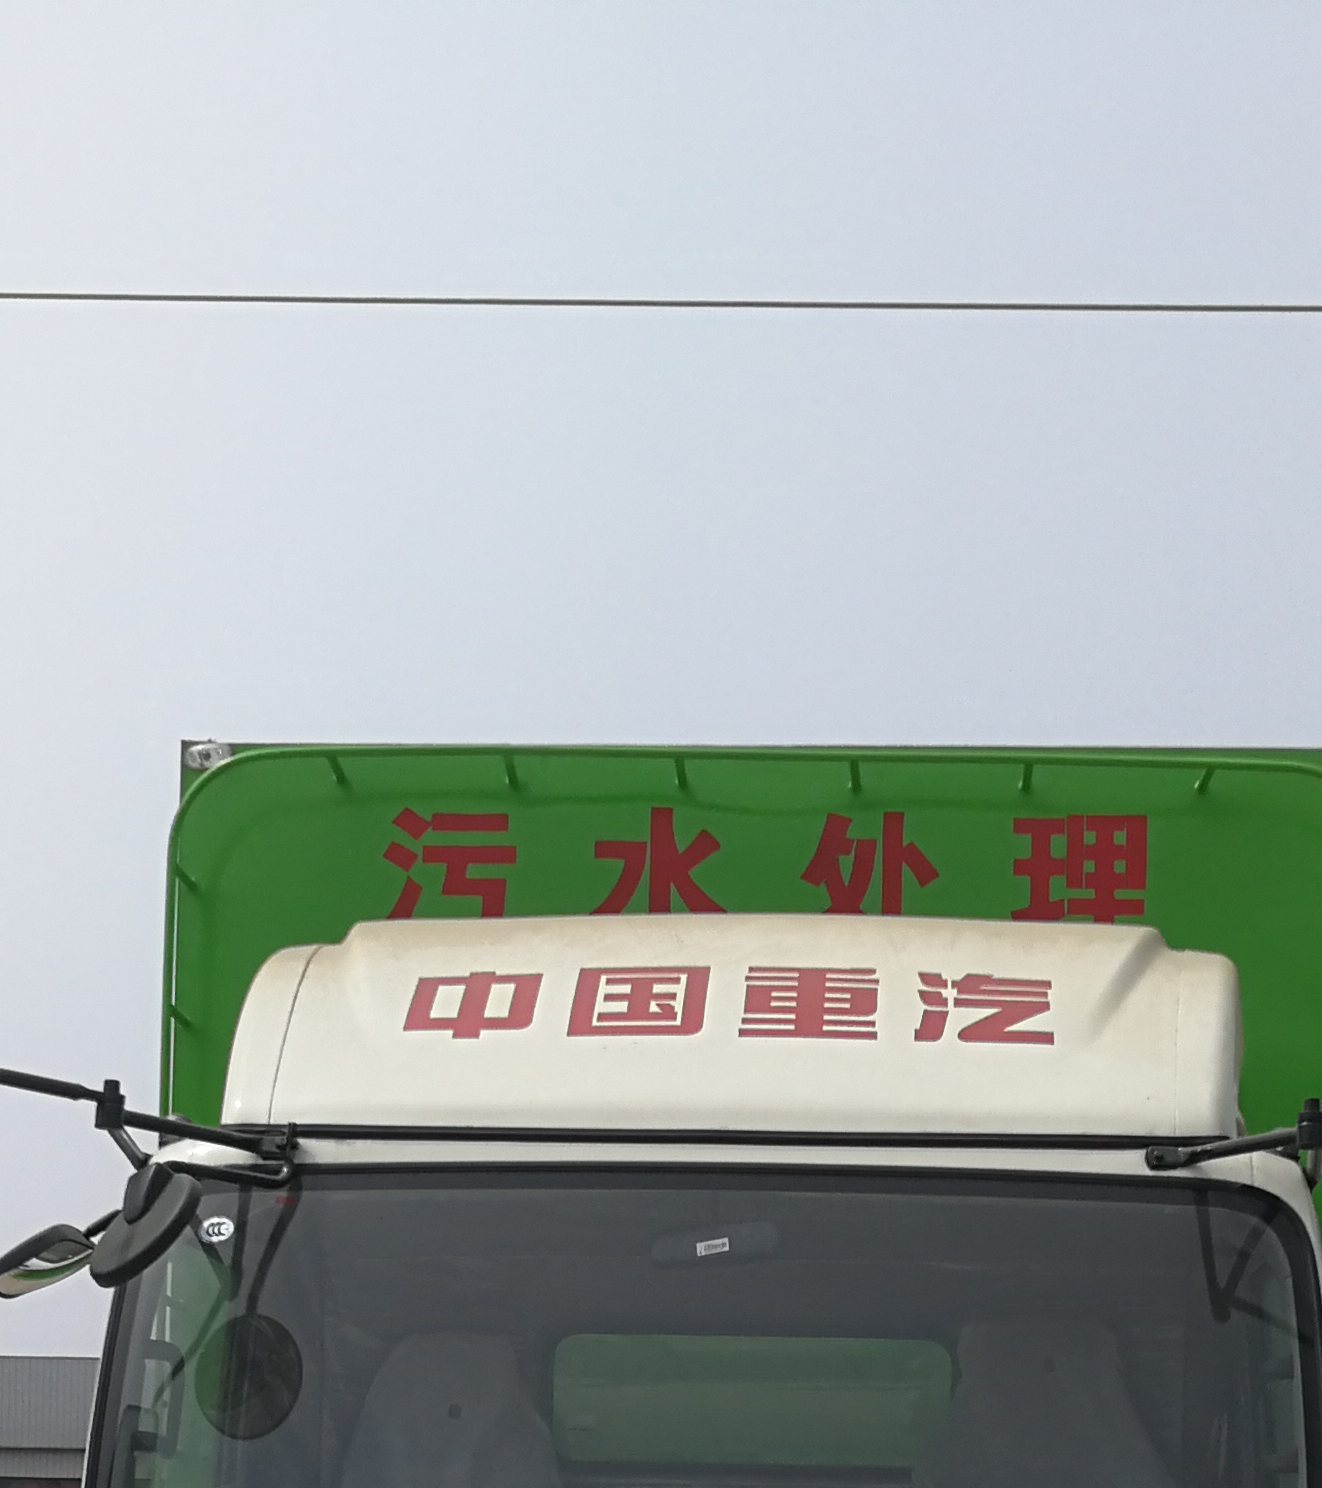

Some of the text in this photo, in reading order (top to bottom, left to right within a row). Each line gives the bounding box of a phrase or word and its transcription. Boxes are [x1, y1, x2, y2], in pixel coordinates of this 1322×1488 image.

[380, 806, 1149, 925] 污水处理
[403, 966, 1055, 1046] 中国重汽
